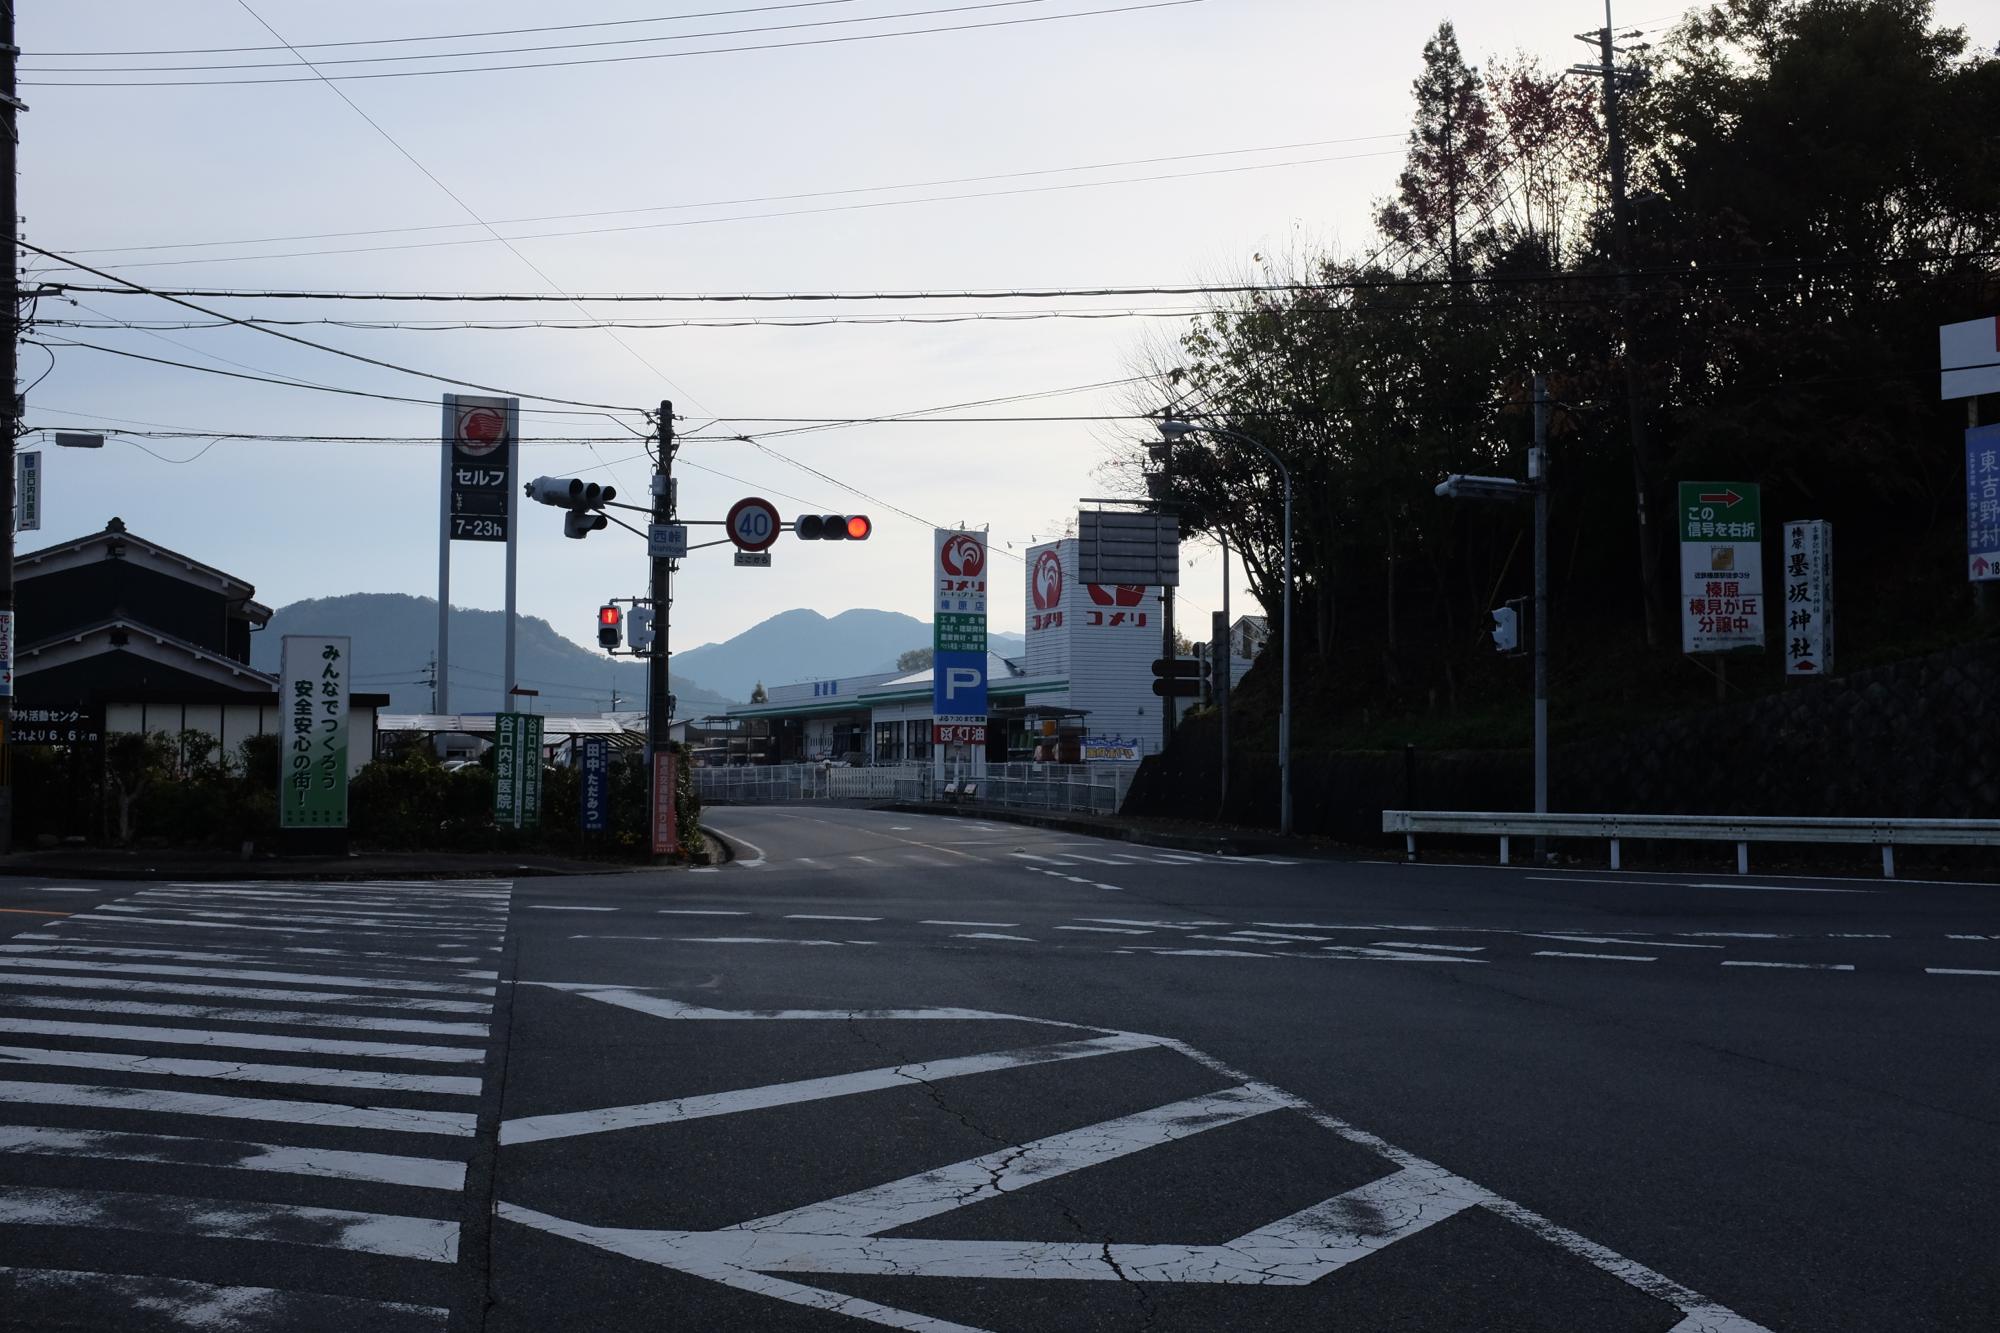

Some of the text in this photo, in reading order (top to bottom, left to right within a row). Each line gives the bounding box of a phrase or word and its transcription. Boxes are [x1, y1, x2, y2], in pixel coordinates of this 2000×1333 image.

[456, 468, 505, 486] セルフ
[1979, 449, 2000, 548] 東吉野村
[1688, 507, 1715, 521] この
[456, 519, 503, 537] 7-23h
[740, 513, 768, 537] 40
[1688, 522, 1756, 537] 信号を右折
[654, 529, 682, 544] 西峠
[1792, 526, 1803, 550] 榛原
[737, 556, 769, 564] ここから
[941, 579, 985, 592] コメリ
[1706, 581, 1740, 598] 榛原
[1689, 598, 1757, 616] 榛見が丘
[1788, 552, 1814, 660] 墨坂神社
[1032, 611, 1063, 631] コメリ
[1086, 610, 1147, 627] コメリ
[1698, 616, 1749, 633] 分譲中
[946, 667, 982, 699] P
[320, 645, 341, 789] みんなでつくろう
[957, 727, 985, 741] 灯油
[293, 680, 313, 807] 安全安心の街！
[496, 715, 515, 810] 谷口内科医院
[525, 718, 537, 811] 谷口内科医院
[586, 743, 600, 821] 田中ただみつ
